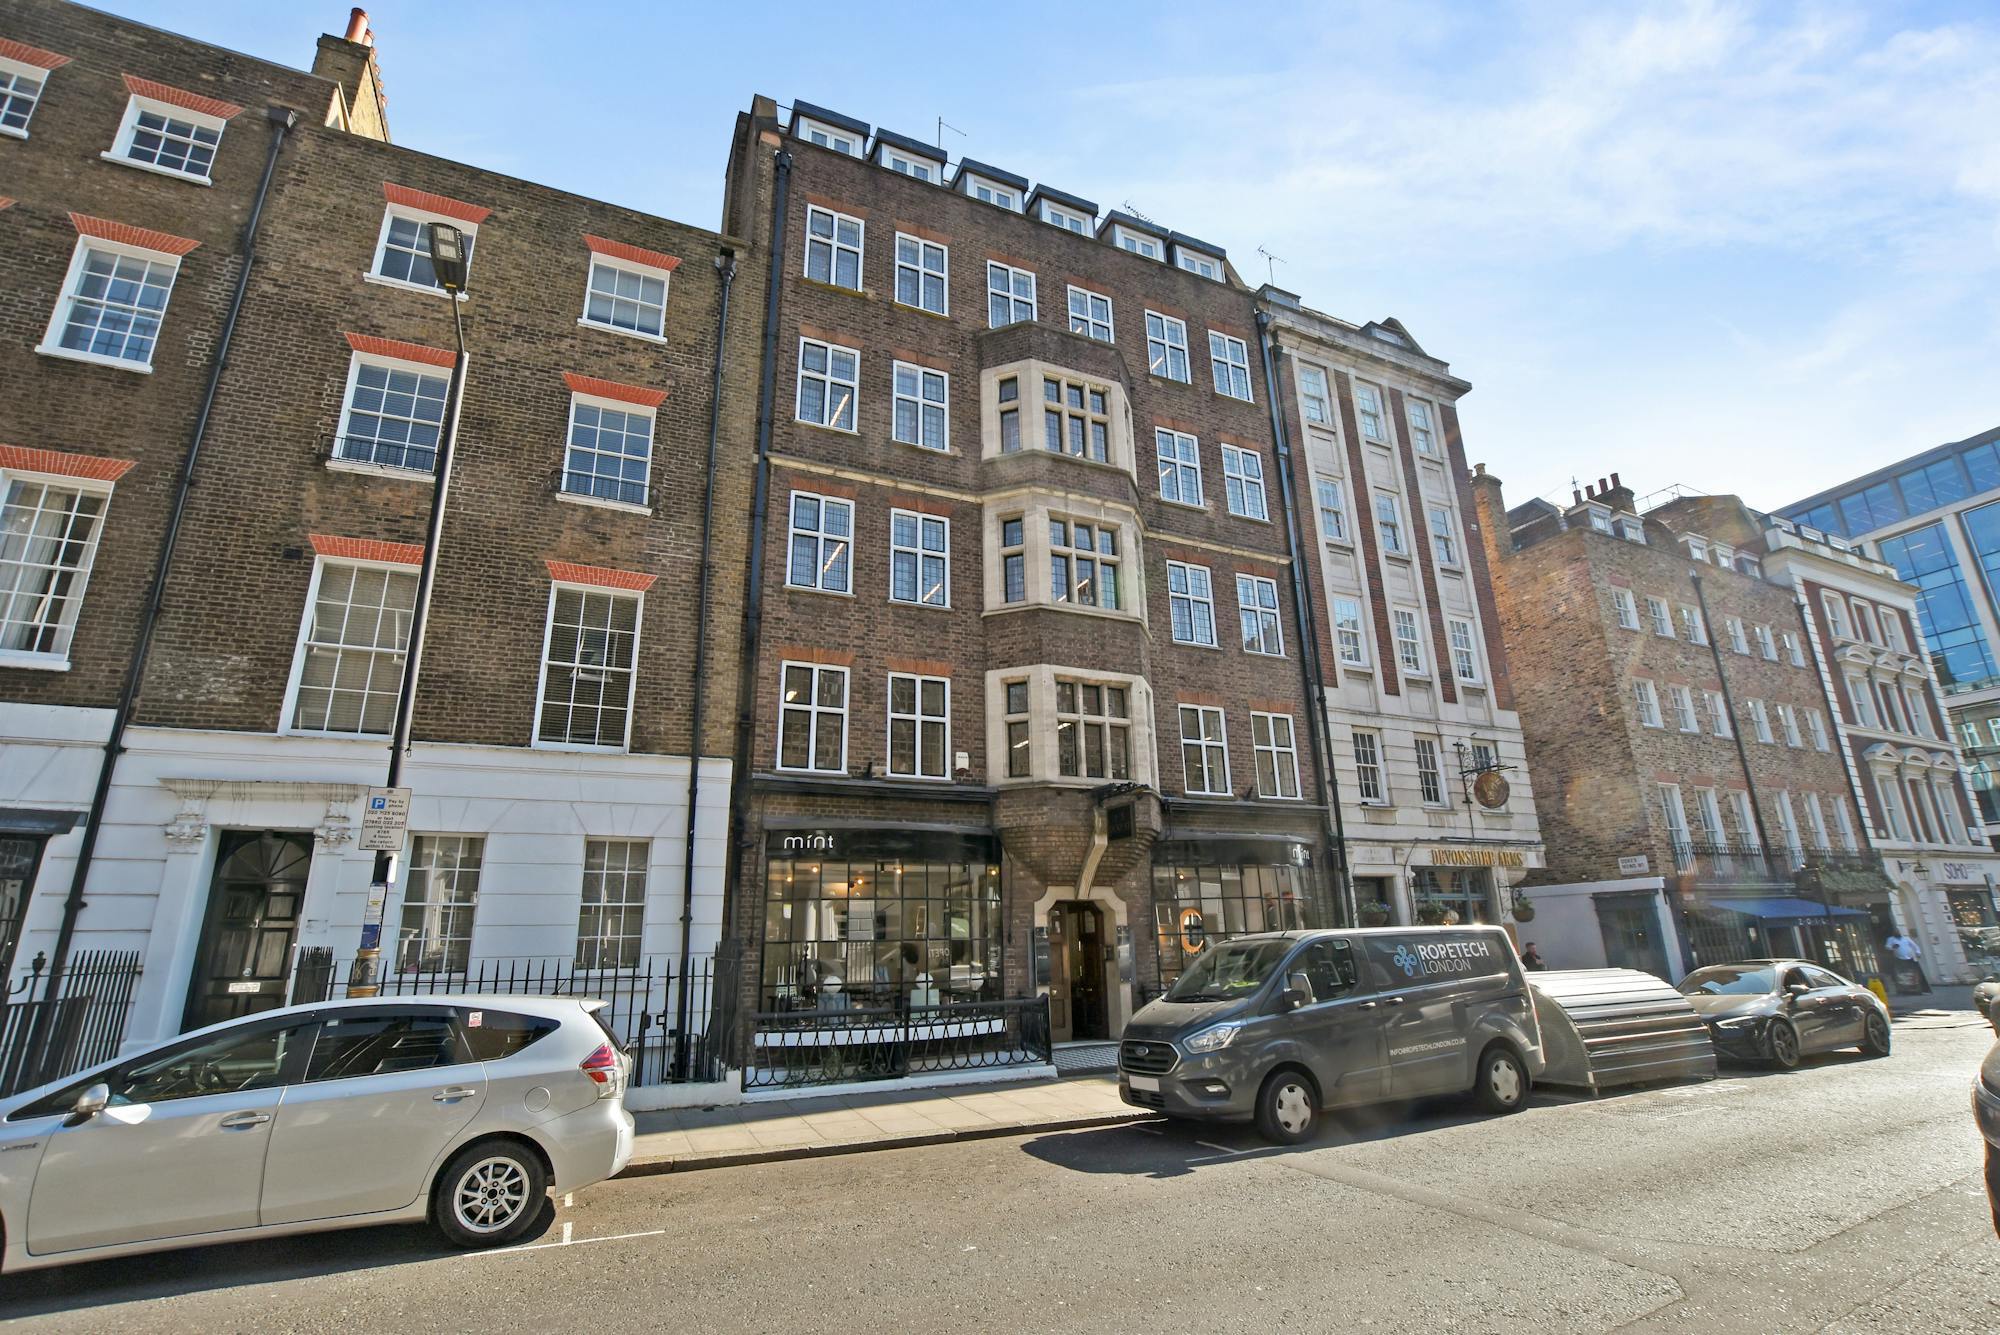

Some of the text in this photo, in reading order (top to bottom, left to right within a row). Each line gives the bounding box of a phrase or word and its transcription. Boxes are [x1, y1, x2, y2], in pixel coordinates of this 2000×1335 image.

[783, 834, 834, 849] mint
[1431, 849, 1524, 866] DEVONSHIRE ARMS
[1944, 862, 1968, 879] SOHO
[1417, 941, 1490, 960] ROPETECH
[1424, 958, 1472, 974] LONDON
